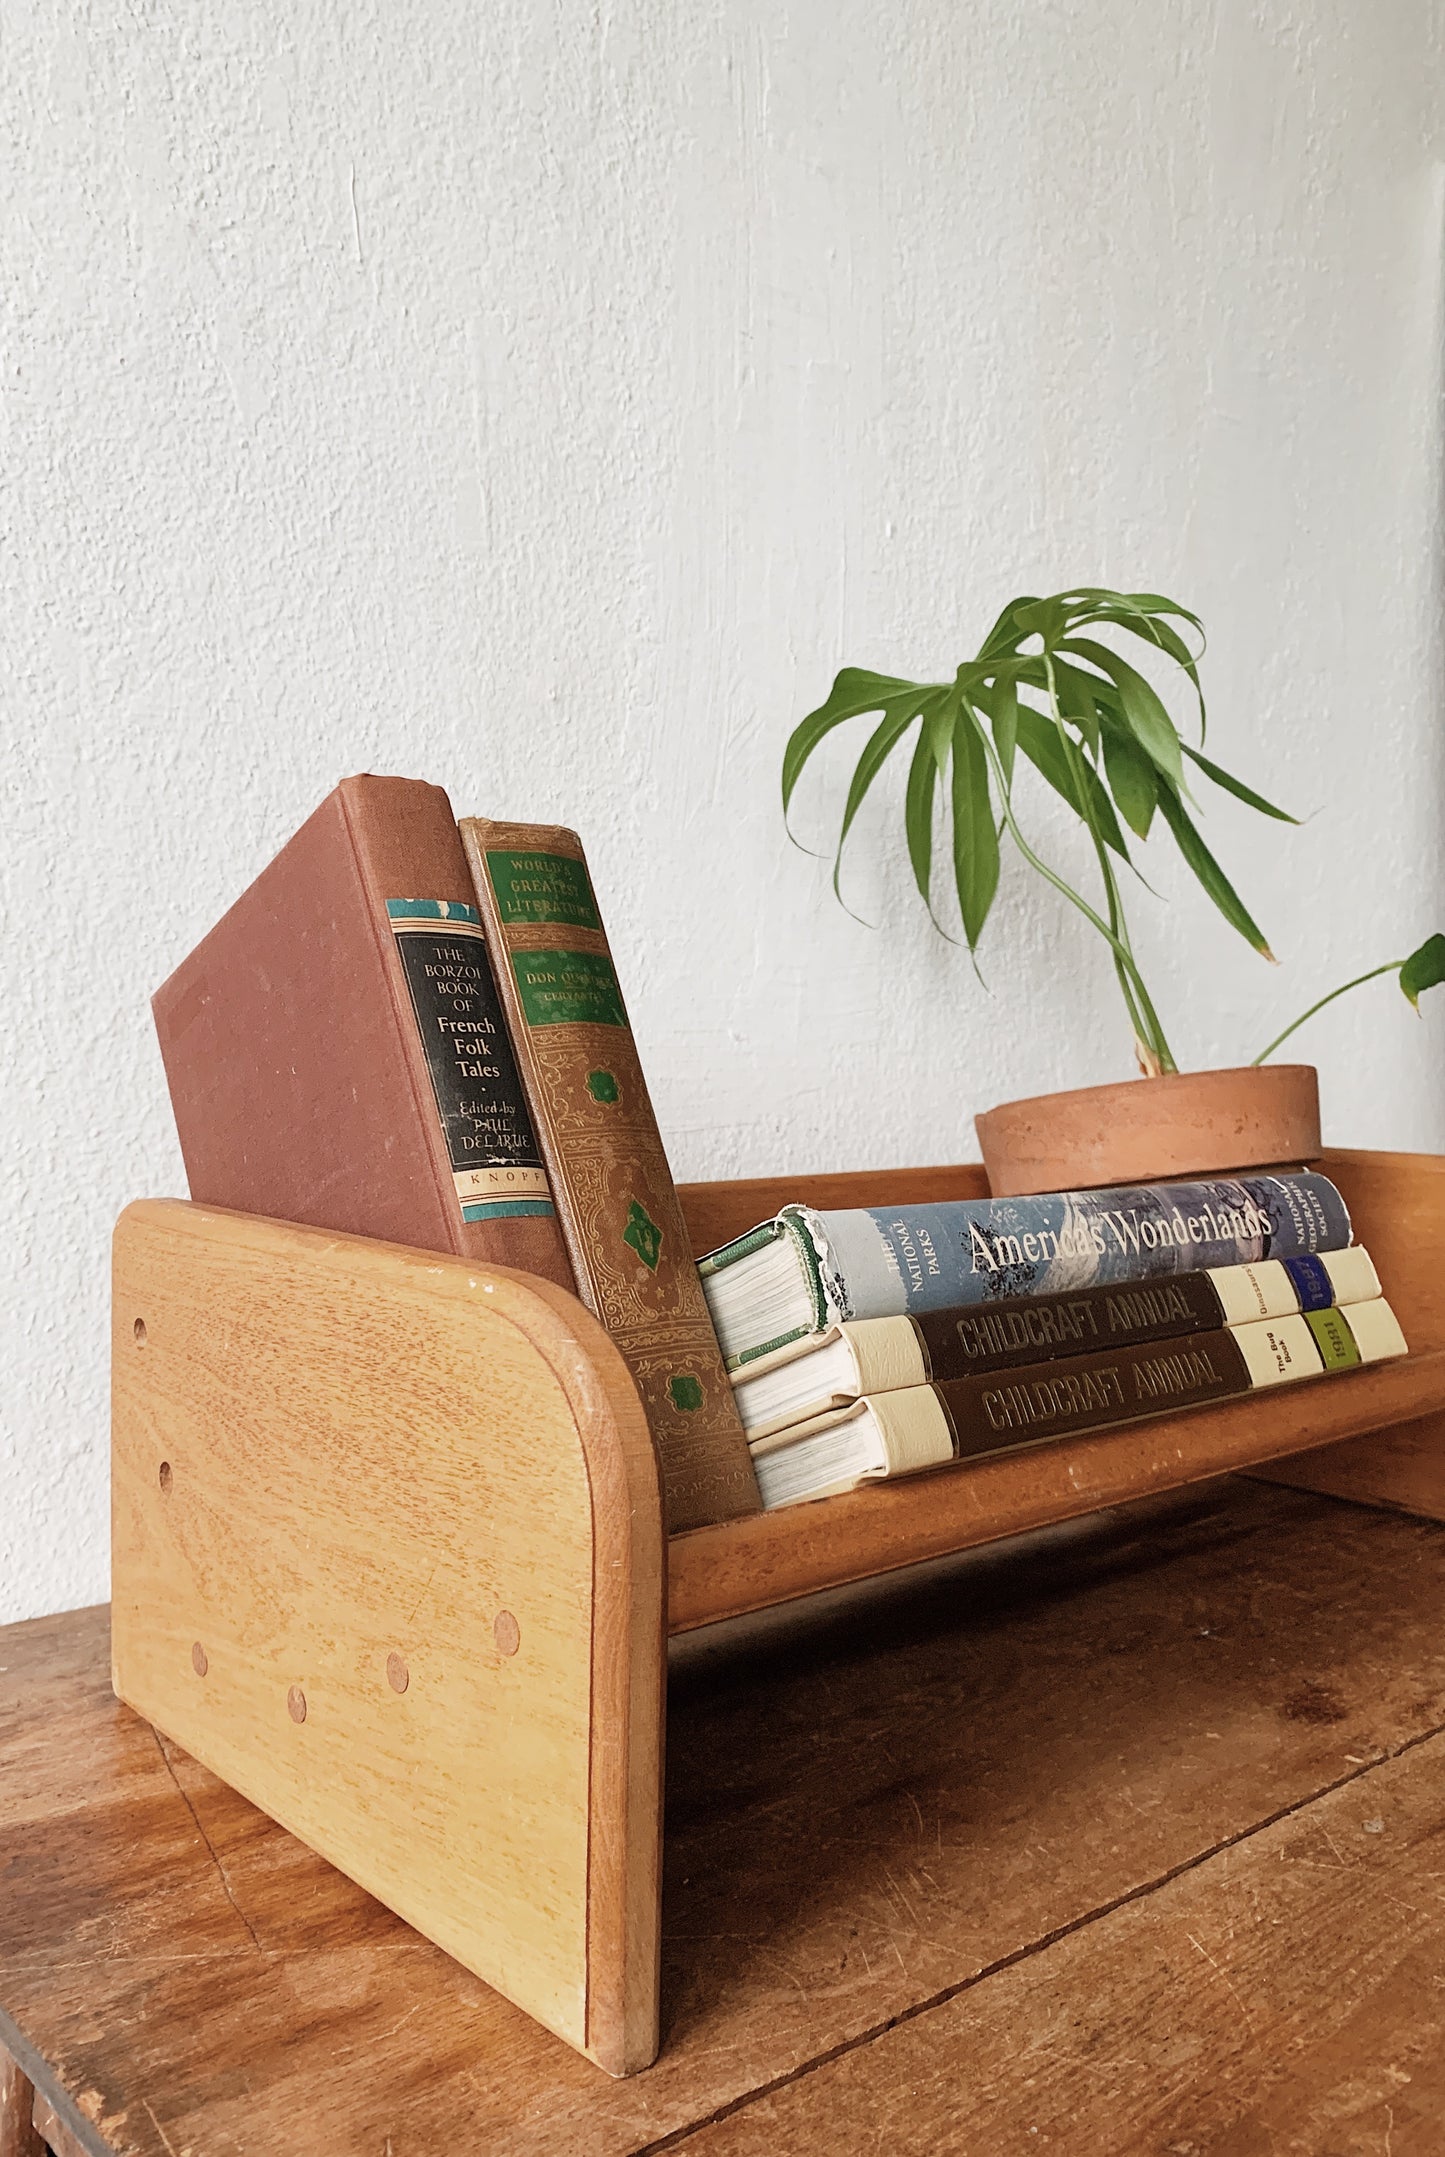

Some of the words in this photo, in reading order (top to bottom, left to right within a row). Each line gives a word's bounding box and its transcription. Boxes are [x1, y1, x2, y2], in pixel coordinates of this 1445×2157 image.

[511, 880, 579, 897] GREATEST
[506, 900, 592, 919] LITERATURE
[433, 947, 465, 962] THE
[424, 964, 482, 980] BORZOI
[526, 972, 556, 985] DON
[436, 981, 480, 996] BOOK
[453, 999, 473, 1012] OF
[437, 1016, 496, 1034] French
[454, 1038, 492, 1055] Folk
[455, 1060, 500, 1077] Tales
[460, 1100, 497, 1115] Edited
[502, 1100, 516, 1116] by
[473, 1118, 511, 1134] PAUL
[460, 1134, 531, 1150] DELARUE
[1280, 1189, 1306, 1245] NATIONAL
[1284, 1180, 1318, 1253] GEOGRAPHIC
[1305, 1189, 1328, 1237] SOCIETY
[1099, 1202, 1273, 1257] Wonderlands
[880, 1240, 901, 1274] THE
[892, 1219, 924, 1293] NATIONAL
[916, 1229, 941, 1276] PARKS
[956, 1301, 1098, 1359] CHILDCRAFT
[1105, 1284, 1198, 1332] ANNUAL
[1266, 1332, 1278, 1351] Bug
[1323, 1321, 1346, 1358] 1981
[1278, 1340, 1292, 1363] Book
[1276, 1355, 1286, 1373] The
[981, 1366, 1125, 1431] CHILDCRAFT
[1132, 1350, 1223, 1399] ANNUAL
